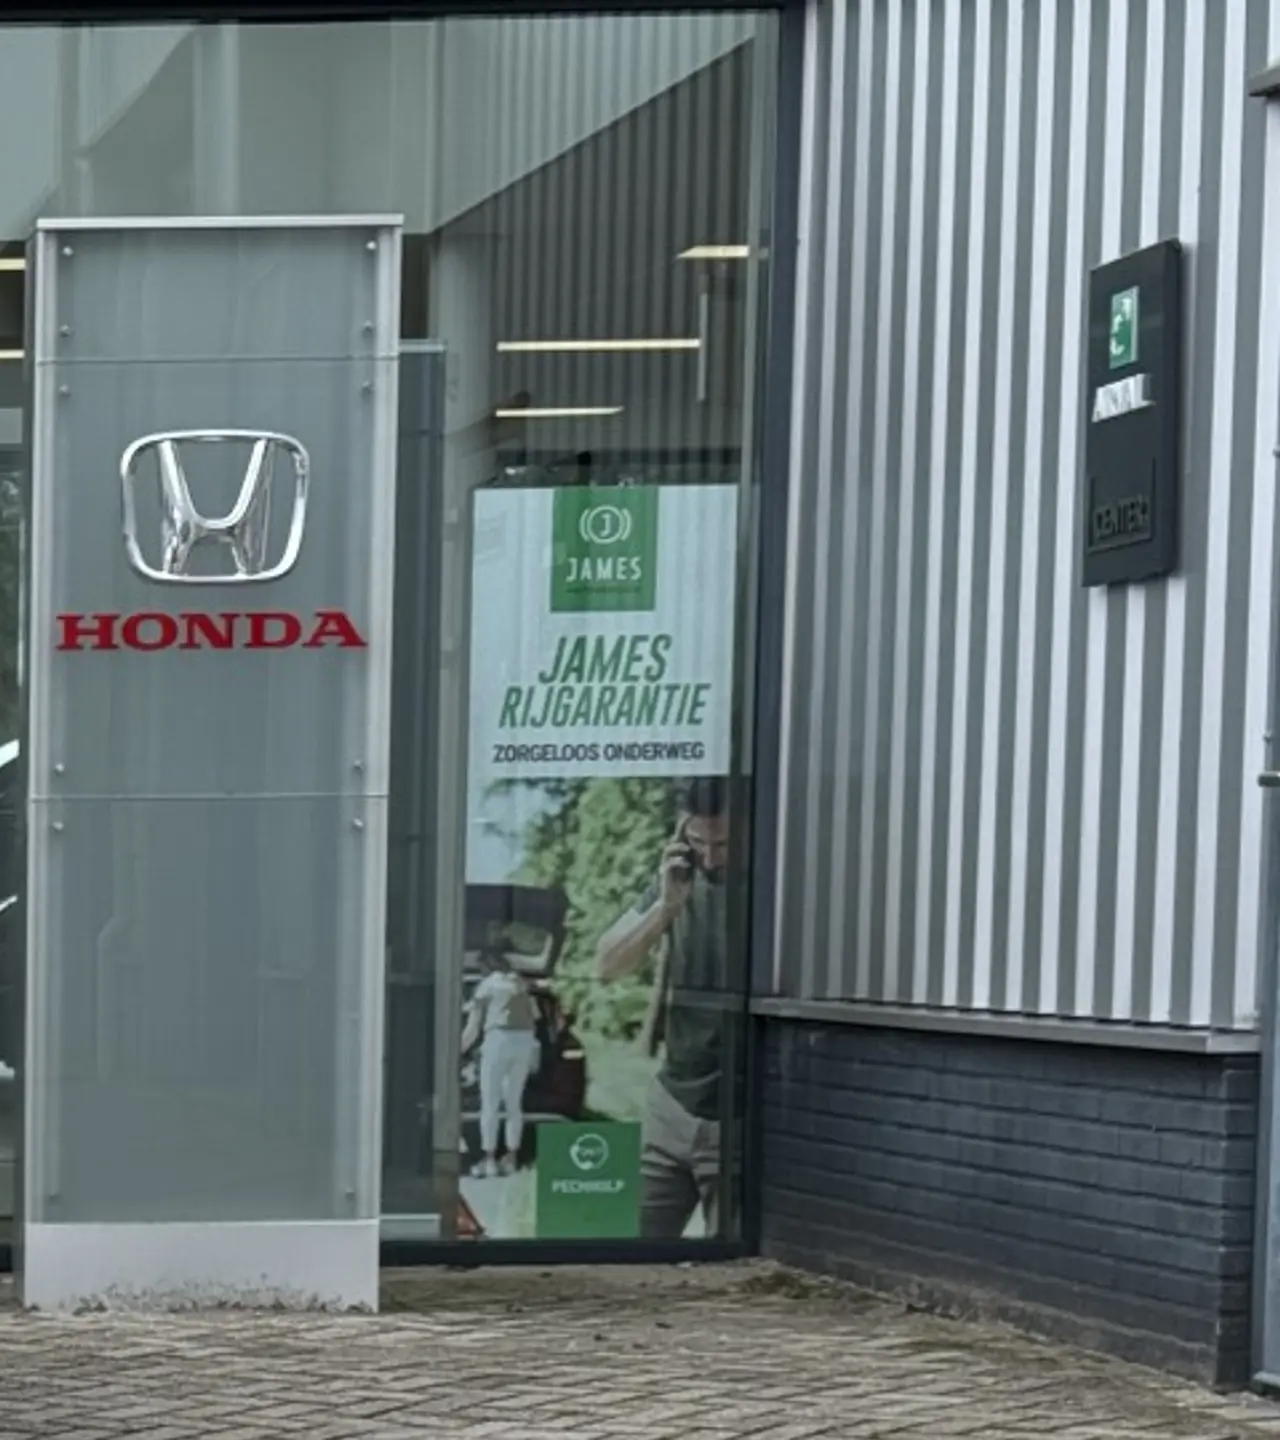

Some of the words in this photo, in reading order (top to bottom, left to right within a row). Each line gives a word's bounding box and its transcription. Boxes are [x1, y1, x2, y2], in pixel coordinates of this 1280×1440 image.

[565, 556, 642, 582] JAMES
[56, 611, 368, 651] HONDA
[538, 634, 672, 684] JAMES
[498, 683, 711, 729] RIJGARANTIE
[493, 743, 601, 764] ZORGELOOS
[603, 741, 705, 762] ONDERWEG
